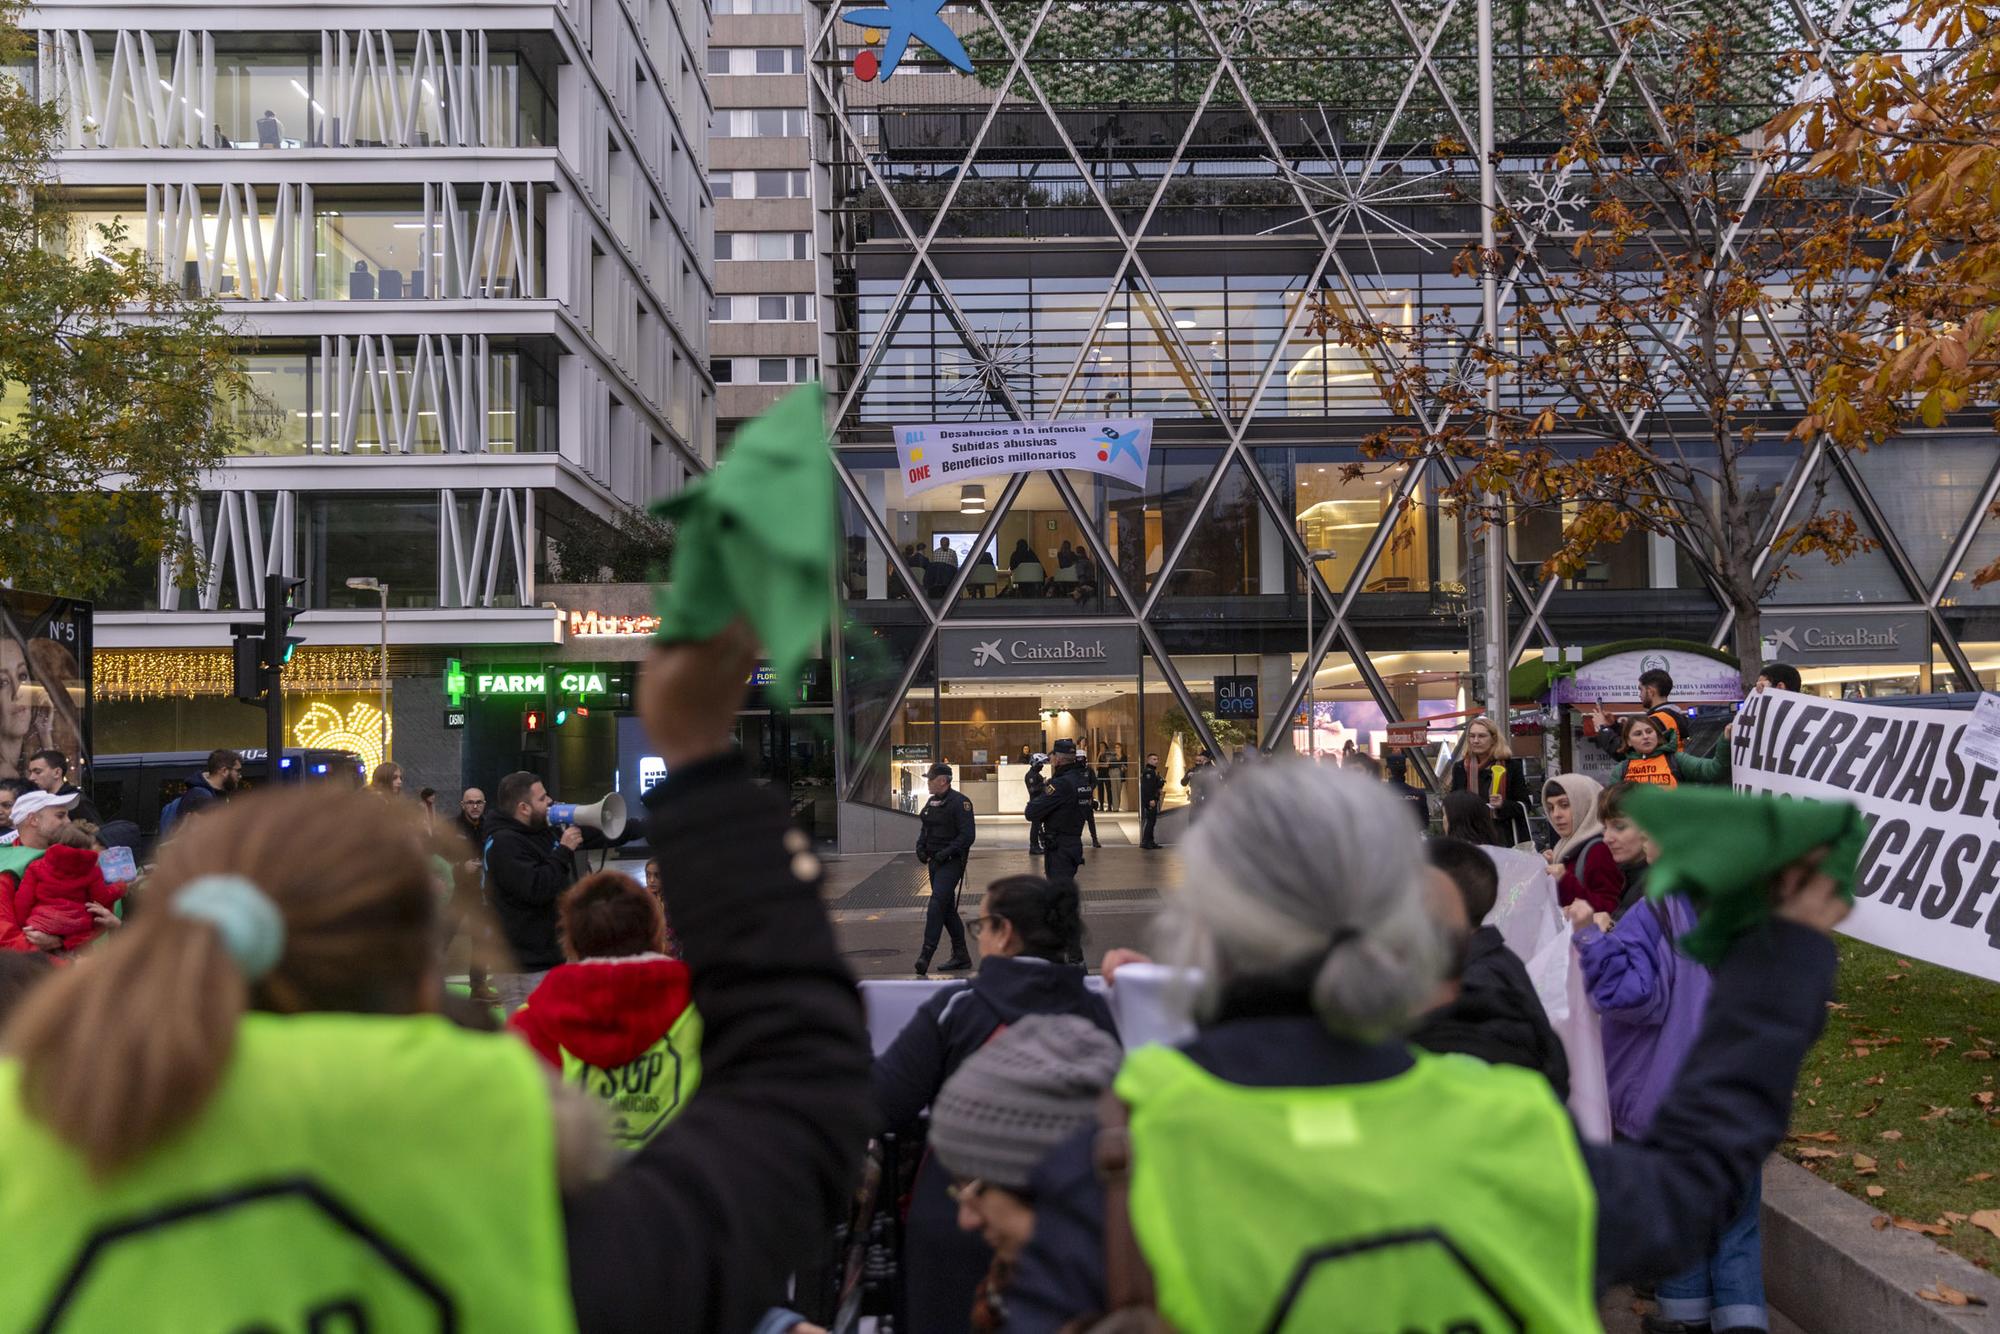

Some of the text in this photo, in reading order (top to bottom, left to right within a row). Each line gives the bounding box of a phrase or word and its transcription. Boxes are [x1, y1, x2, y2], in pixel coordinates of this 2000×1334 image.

[905, 431, 926, 445] ALL
[940, 427, 1009, 439] Desahucios
[1023, 427, 1034, 435] la
[1038, 425, 1087, 434] infancia
[952, 438, 1057, 453] Subidas abusivas
[942, 451, 1077, 473] Beneficios millonarios
[908, 464, 931, 483] ONE
[1803, 627, 1898, 647] CaixaBank
[1010, 640, 1107, 659] CaixaBank
[478, 674, 603, 693] FARMCIA
[1220, 682, 1254, 698] all in
[1220, 698, 1254, 710] one
[1734, 695, 2000, 820] #LLERENASE
